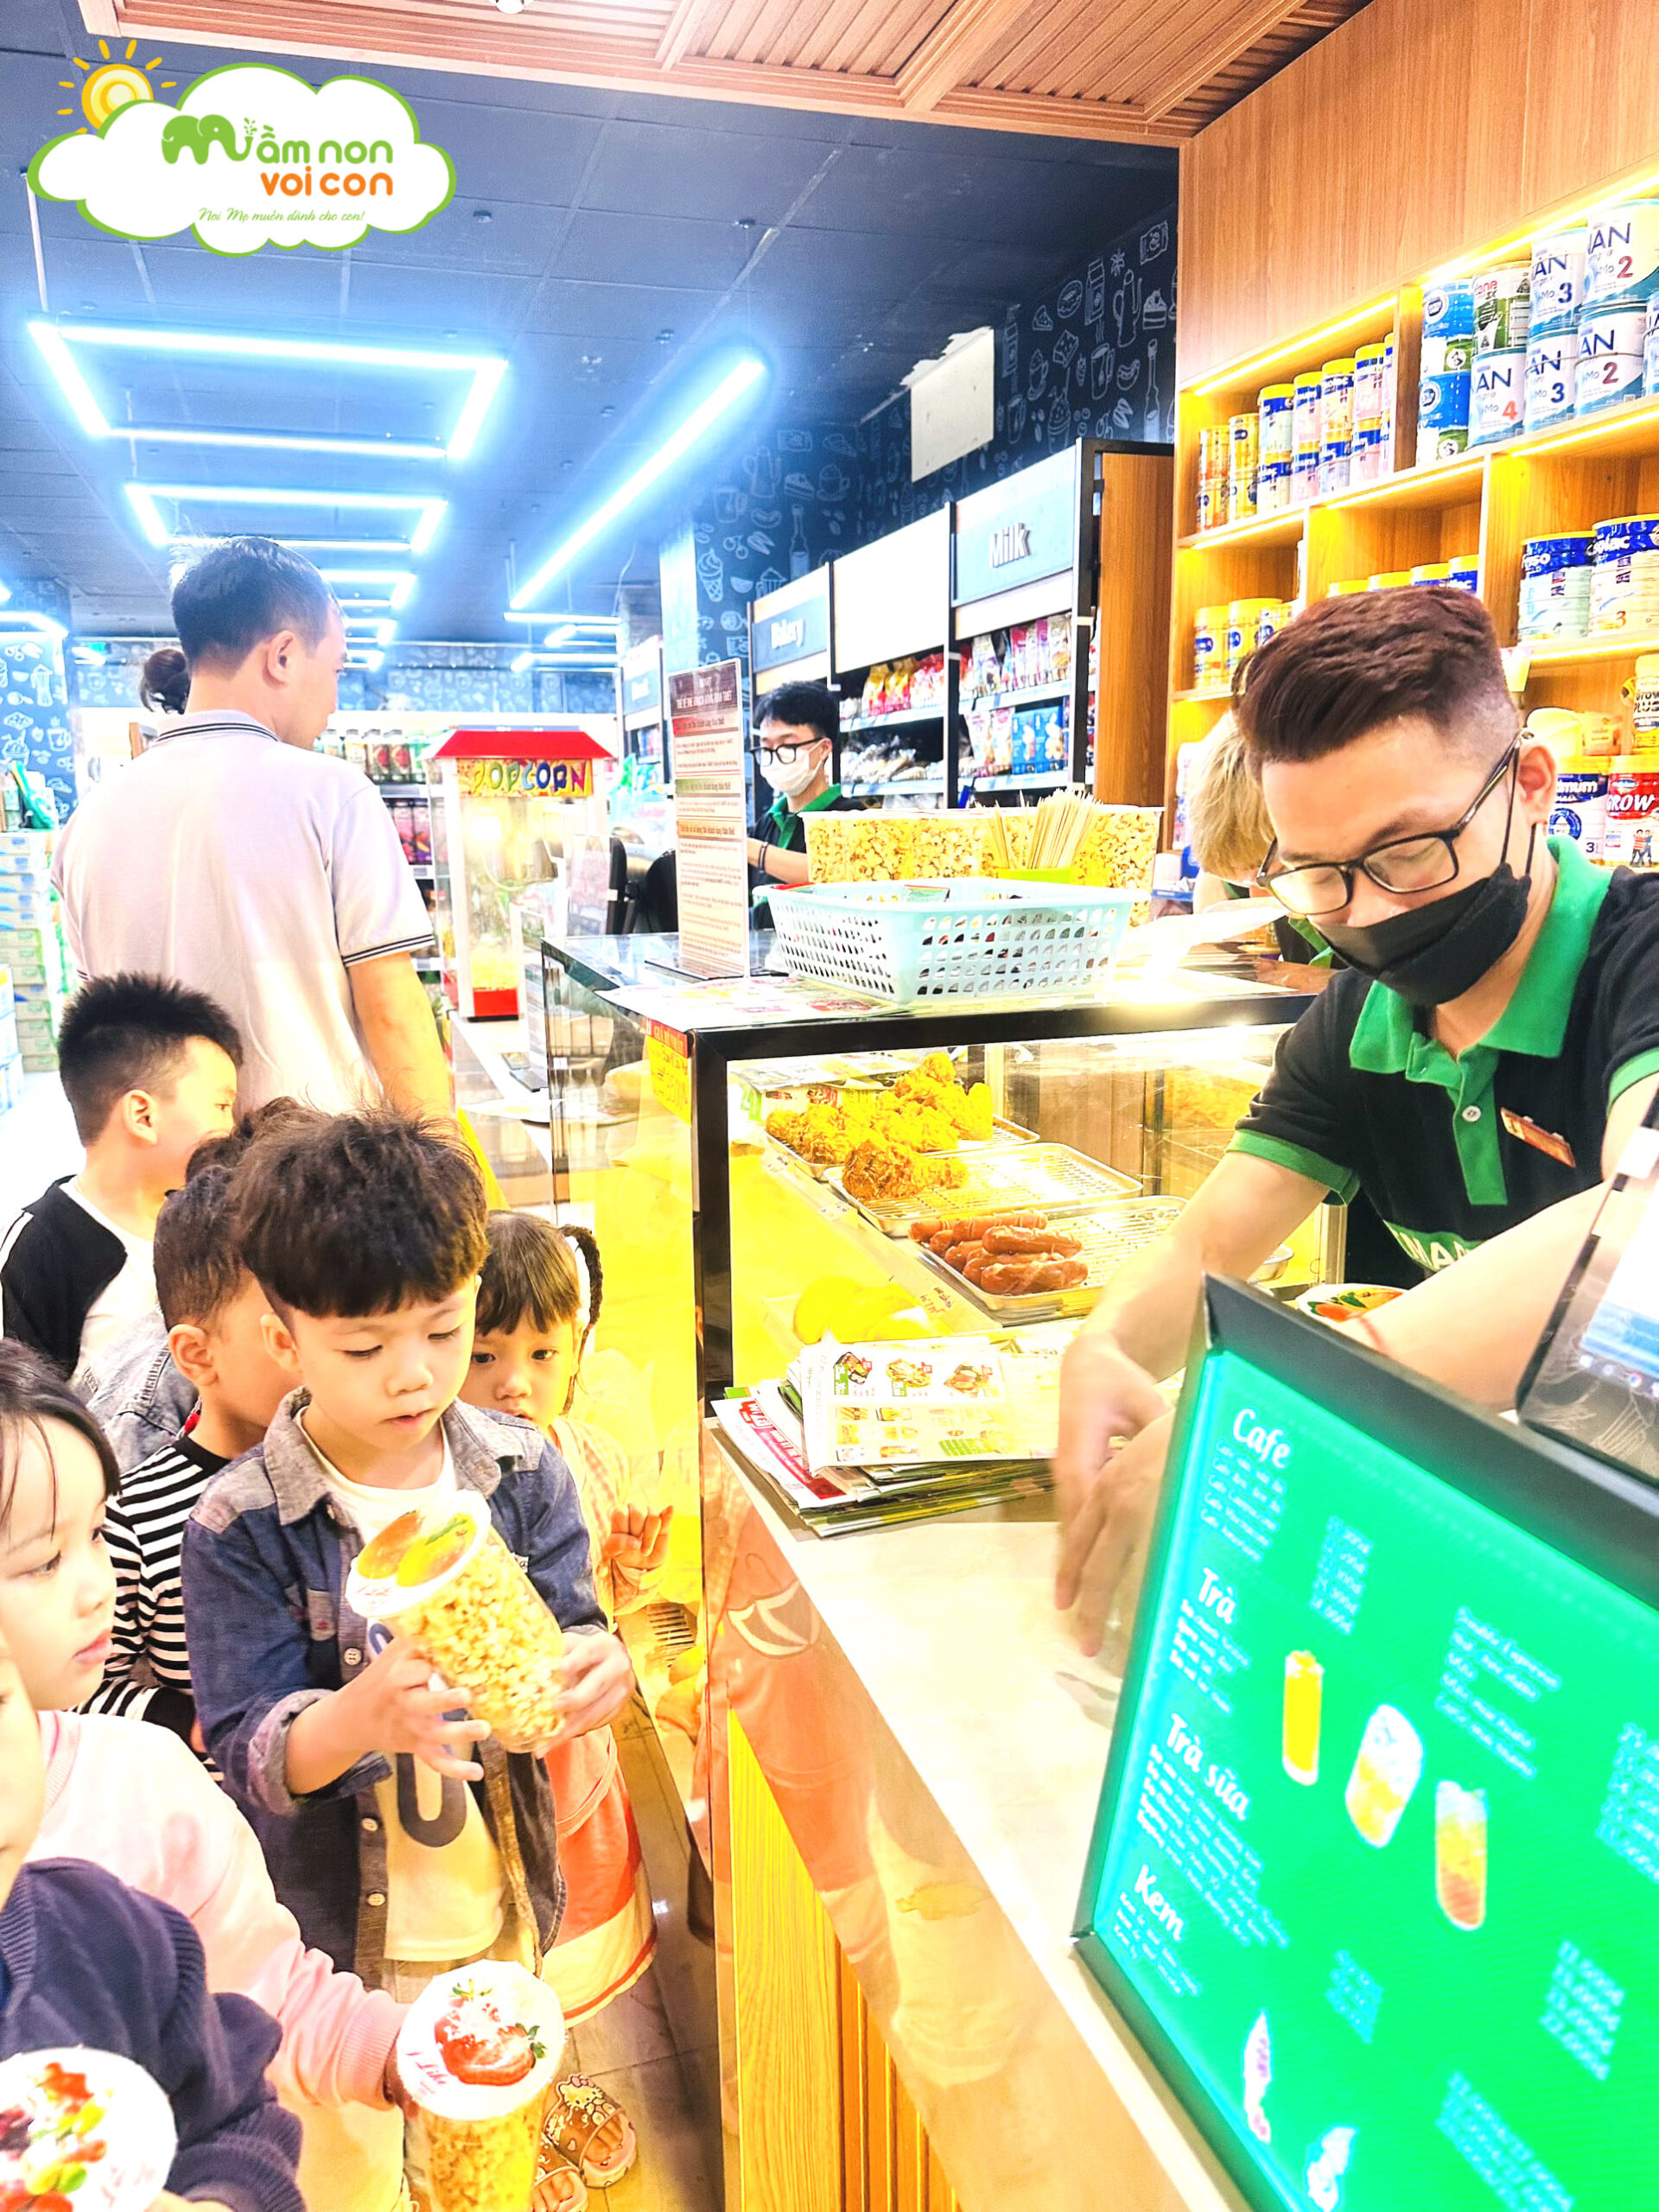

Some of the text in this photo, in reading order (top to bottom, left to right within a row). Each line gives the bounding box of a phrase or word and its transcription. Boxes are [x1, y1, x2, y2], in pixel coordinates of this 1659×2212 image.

[1532, 253, 1569, 281] AN
[1617, 255, 1634, 279] 2
[1558, 282, 1573, 304] 3
[1578, 329, 1614, 356] AN
[1529, 350, 1561, 375] AN
[1602, 361, 1619, 385] 2
[1476, 367, 1512, 394] AN
[1550, 382, 1566, 404] 3
[1502, 400, 1518, 421] 4
[988, 522, 1030, 568] Milk
[473, 762, 586, 793] POPCORN
[1586, 842, 1596, 854] 3
[1233, 1408, 1292, 1469] Cafe
[1198, 1567, 1236, 1624] Trà
[1166, 1713, 1205, 1773] Trà
[1134, 1864, 1185, 1941] Kem
